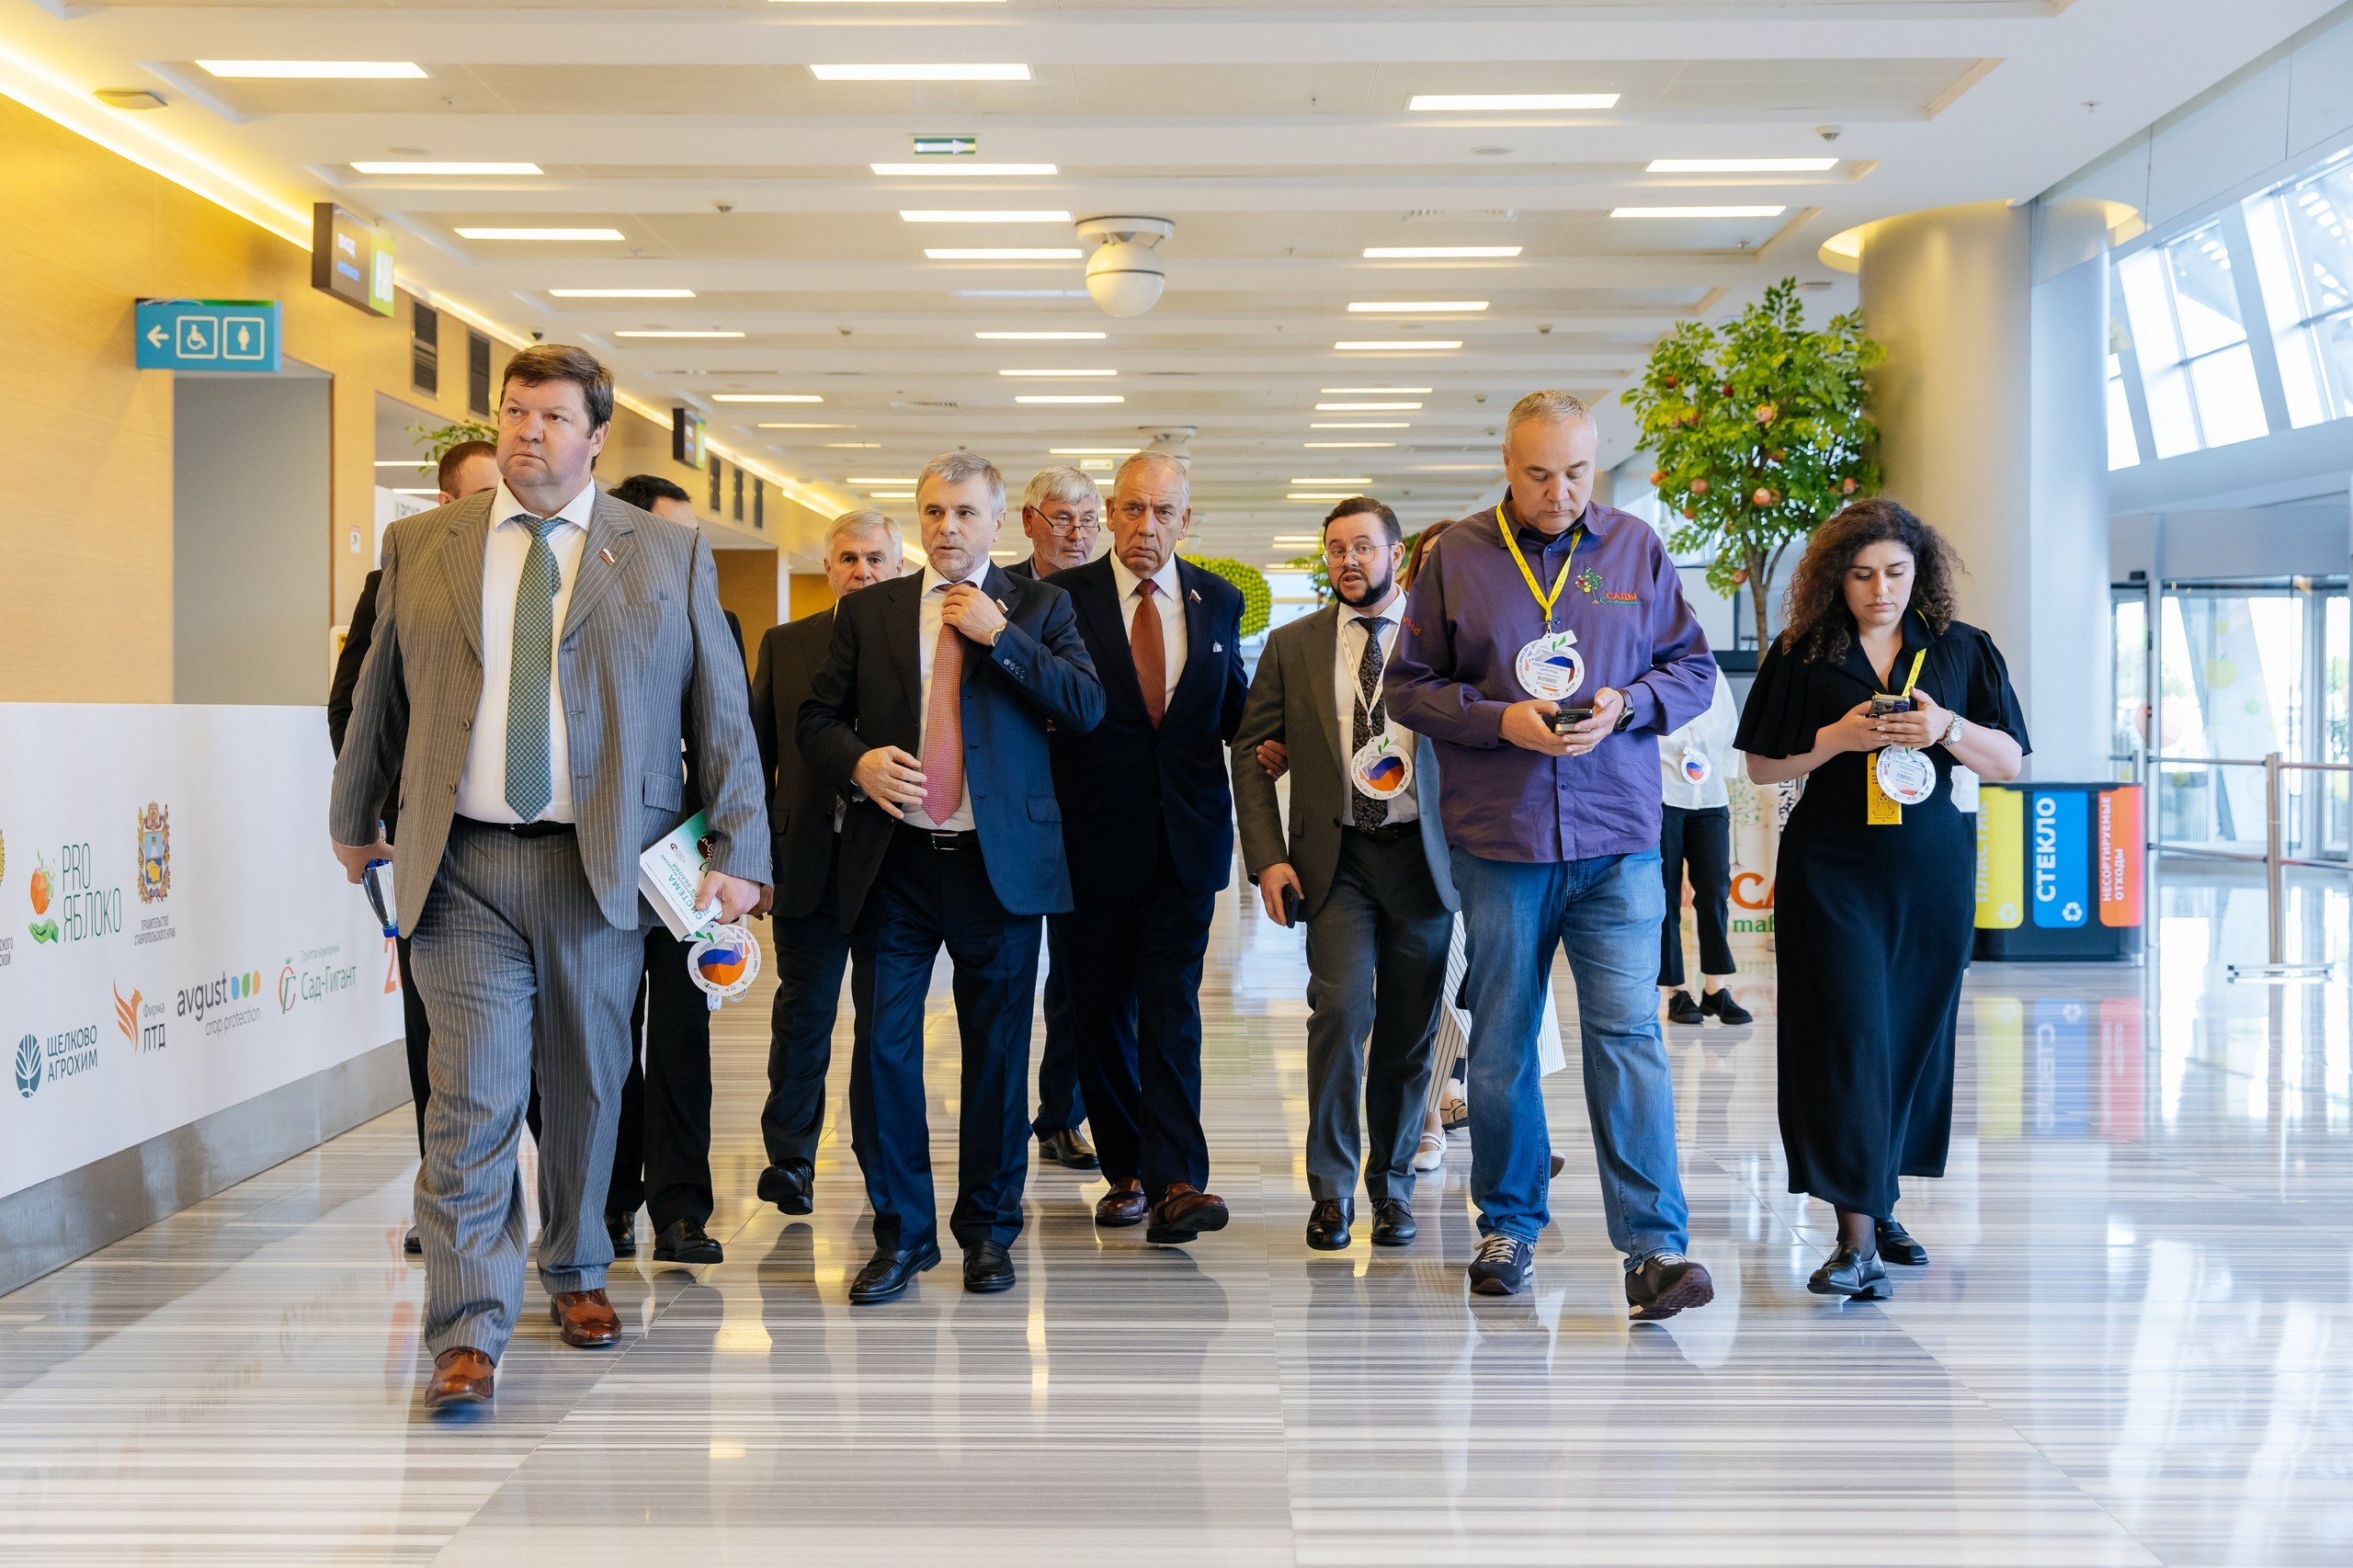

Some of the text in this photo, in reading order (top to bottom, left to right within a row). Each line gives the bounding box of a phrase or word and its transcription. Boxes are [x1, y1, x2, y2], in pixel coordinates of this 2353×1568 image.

[63, 843, 91, 892] PRO
[2036, 797, 2056, 902] СТЕКЛО
[2101, 796, 2112, 902] НЕСОРТИРУЕМЫЕ
[668, 874, 702, 920] СИСТЕМА
[2114, 847, 2125, 901] ОТХОДЫ
[63, 888, 121, 942] ЯБЛОКО
[177, 971, 227, 1021] avgust
[301, 965, 357, 1003] Сад-Гигант
[143, 1003, 165, 1019] Фирма
[205, 1006, 261, 1037] crop protection
[47, 1025, 97, 1057] ЩЕЛКОВО
[143, 1023, 165, 1053] ЛТД
[48, 1048, 97, 1083] АГРОХИМ
